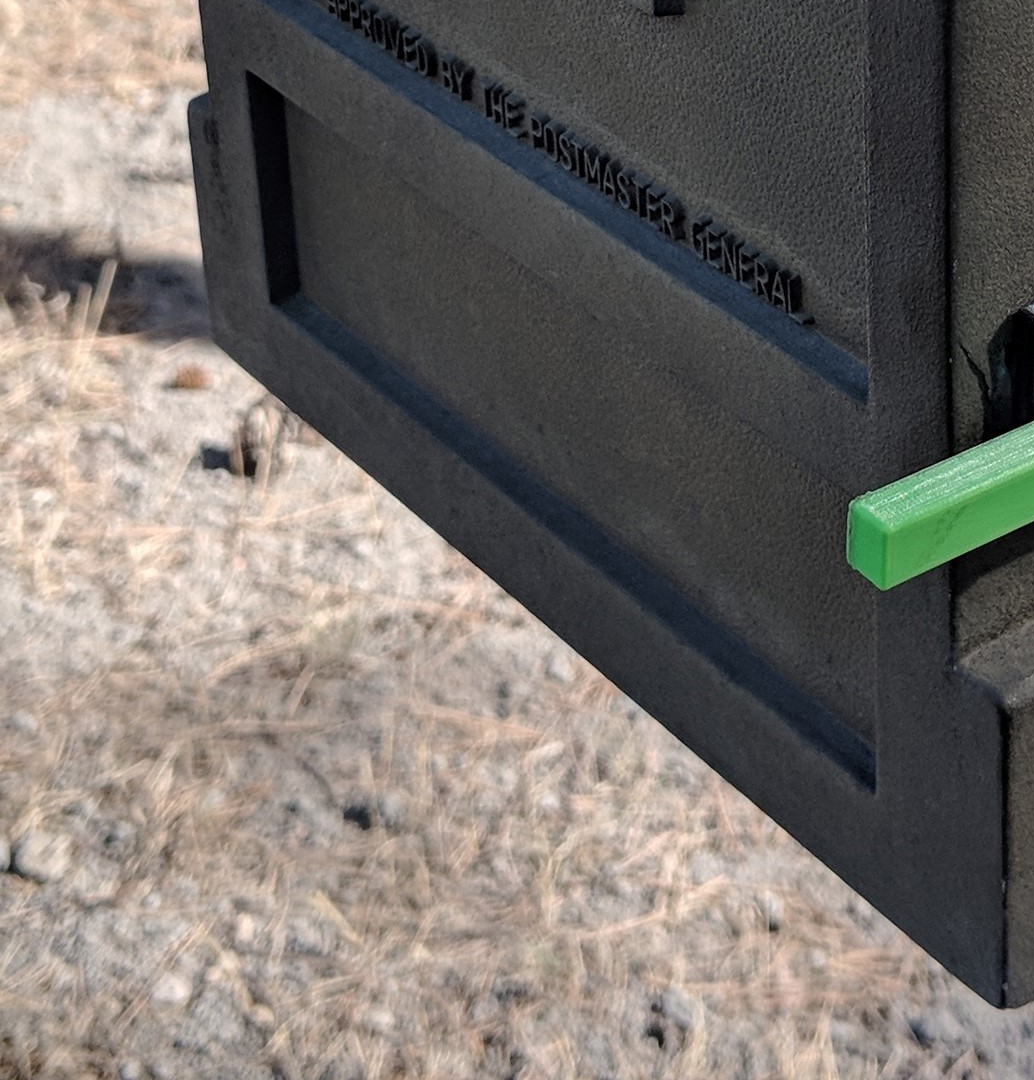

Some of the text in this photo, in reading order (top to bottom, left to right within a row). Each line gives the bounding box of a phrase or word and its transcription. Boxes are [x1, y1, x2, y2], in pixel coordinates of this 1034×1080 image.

[440, 52, 475, 101] BY
[481, 77, 527, 139] THE
[529, 110, 686, 241] POSTMASTER
[690, 215, 812, 325] GENERAL
